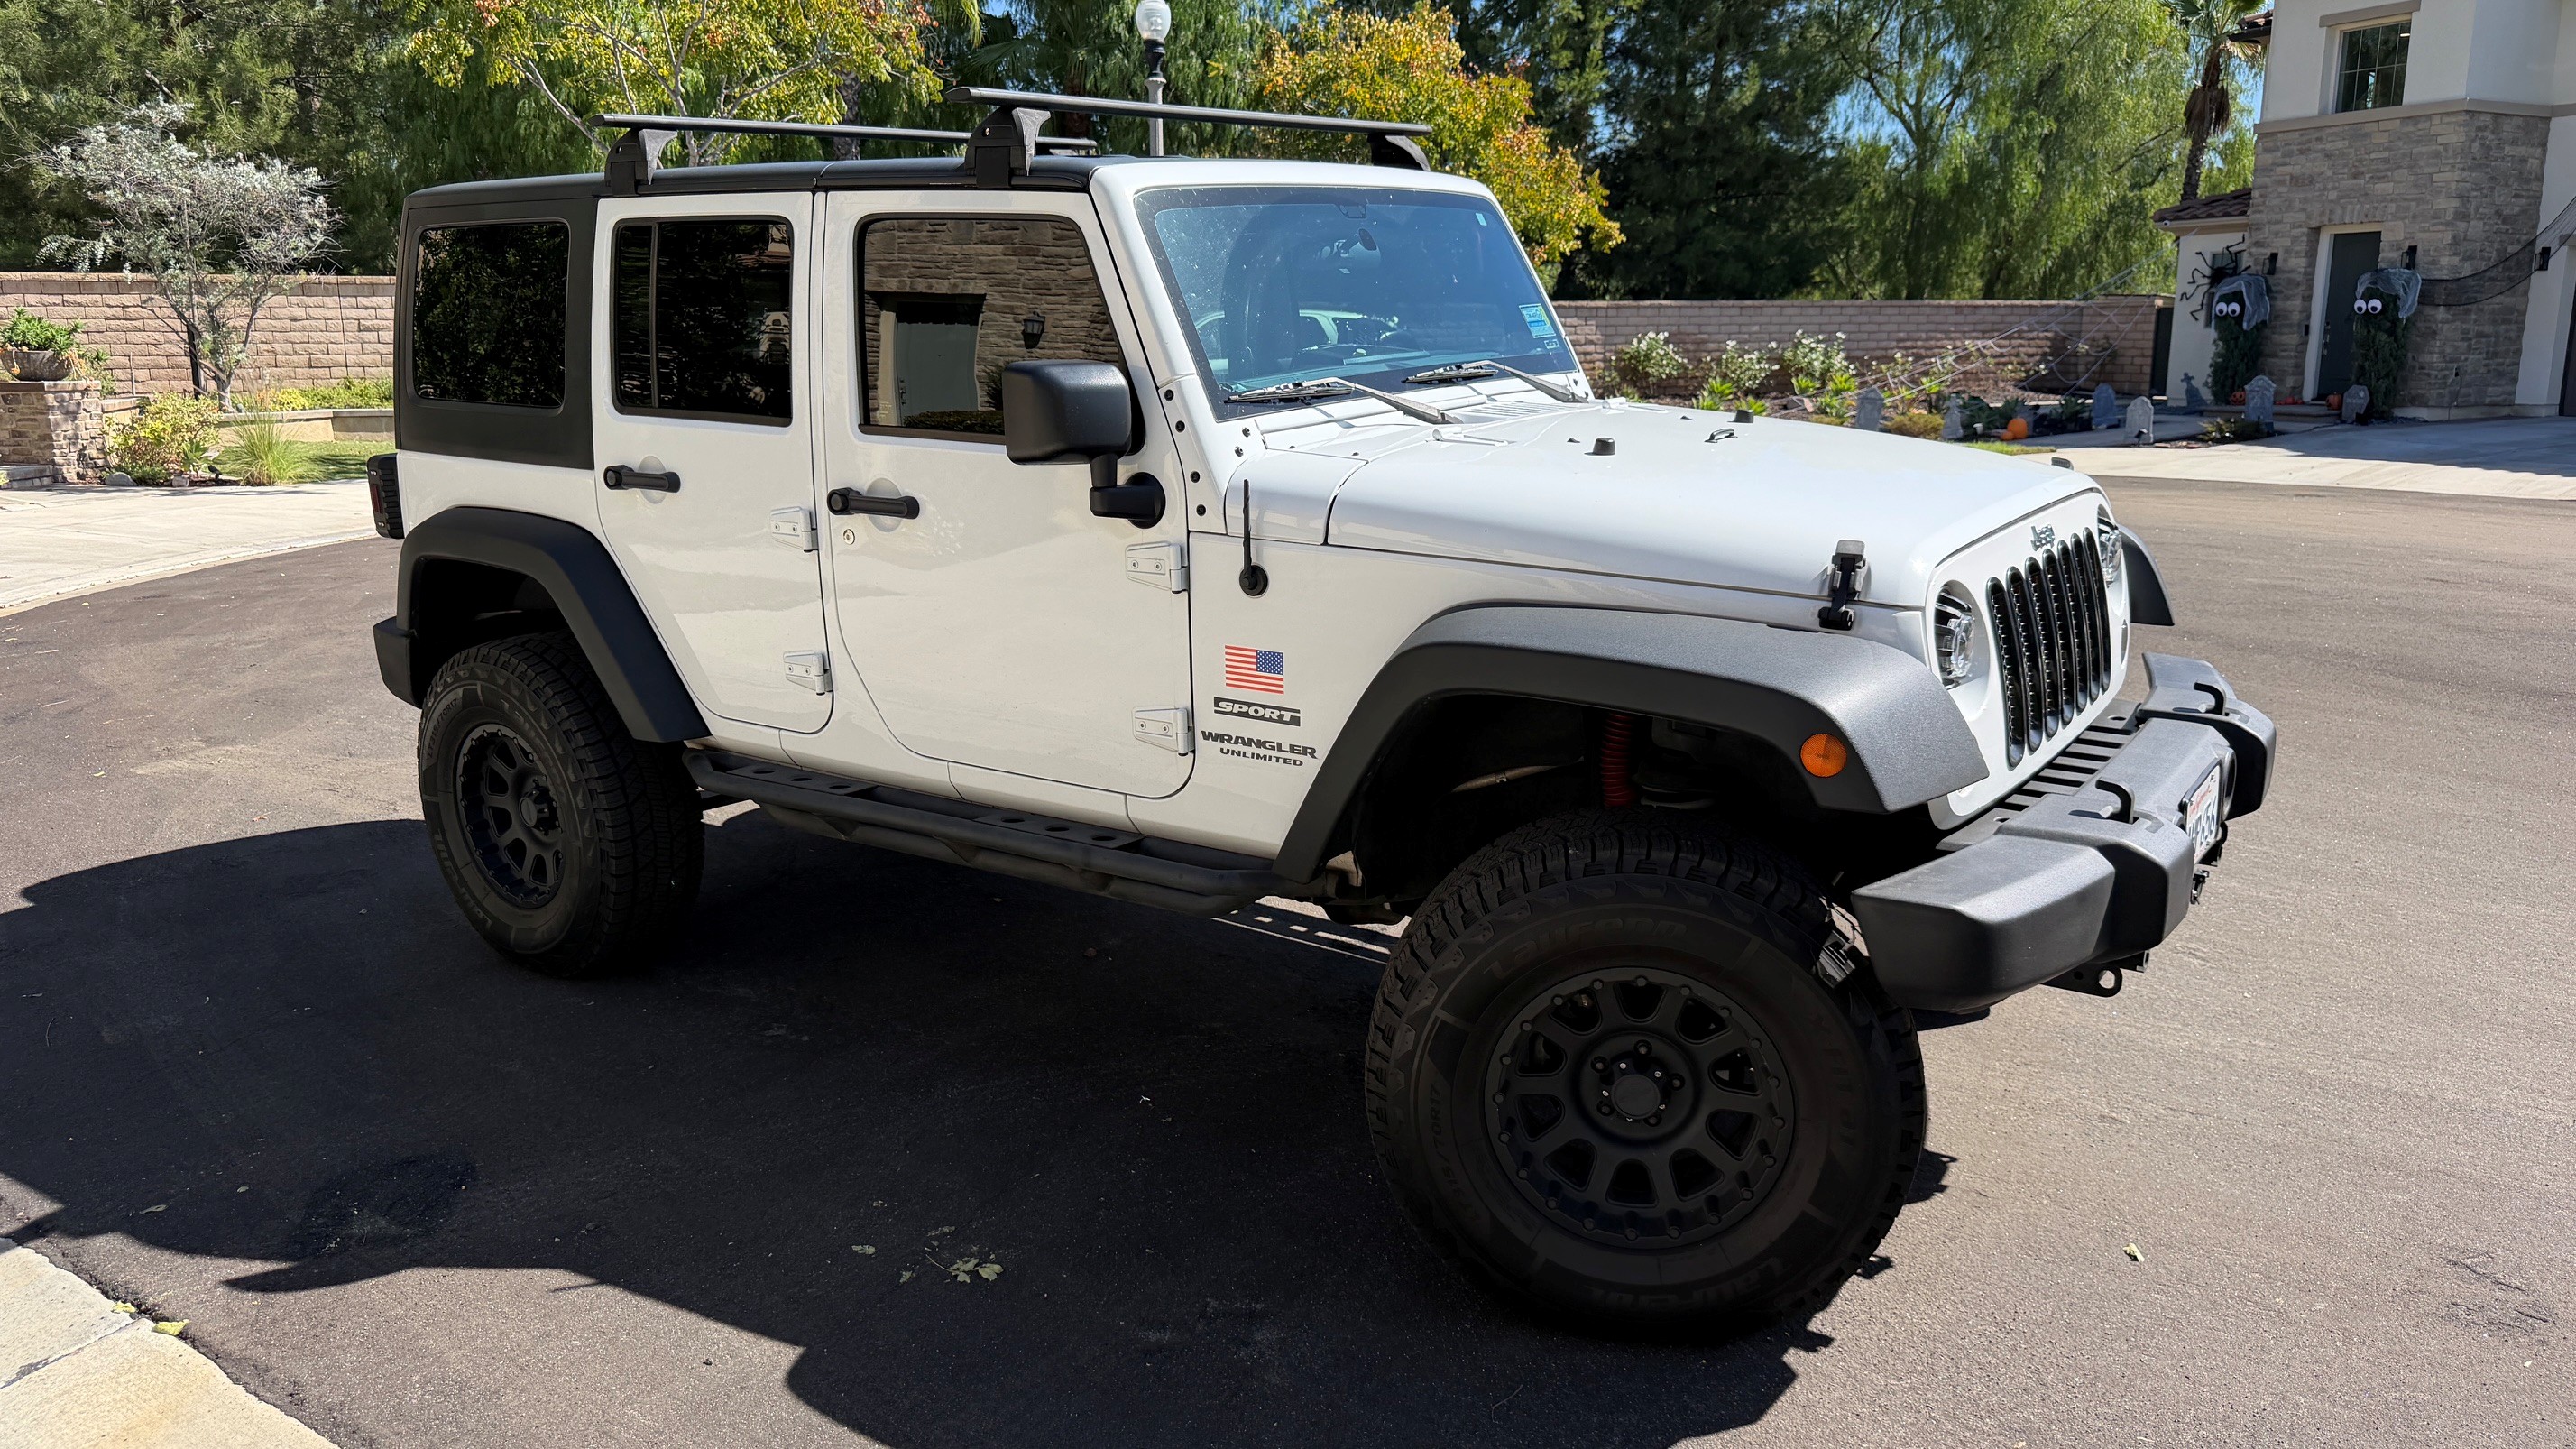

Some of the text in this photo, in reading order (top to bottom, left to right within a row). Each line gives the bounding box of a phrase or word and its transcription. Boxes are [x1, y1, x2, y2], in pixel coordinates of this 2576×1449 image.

[2030, 524, 2056, 551] Jeep
[1217, 700, 1297, 723] SPORT
[1201, 730, 1319, 759] WRANGLER
[1220, 747, 1303, 766] UNLIMITED
